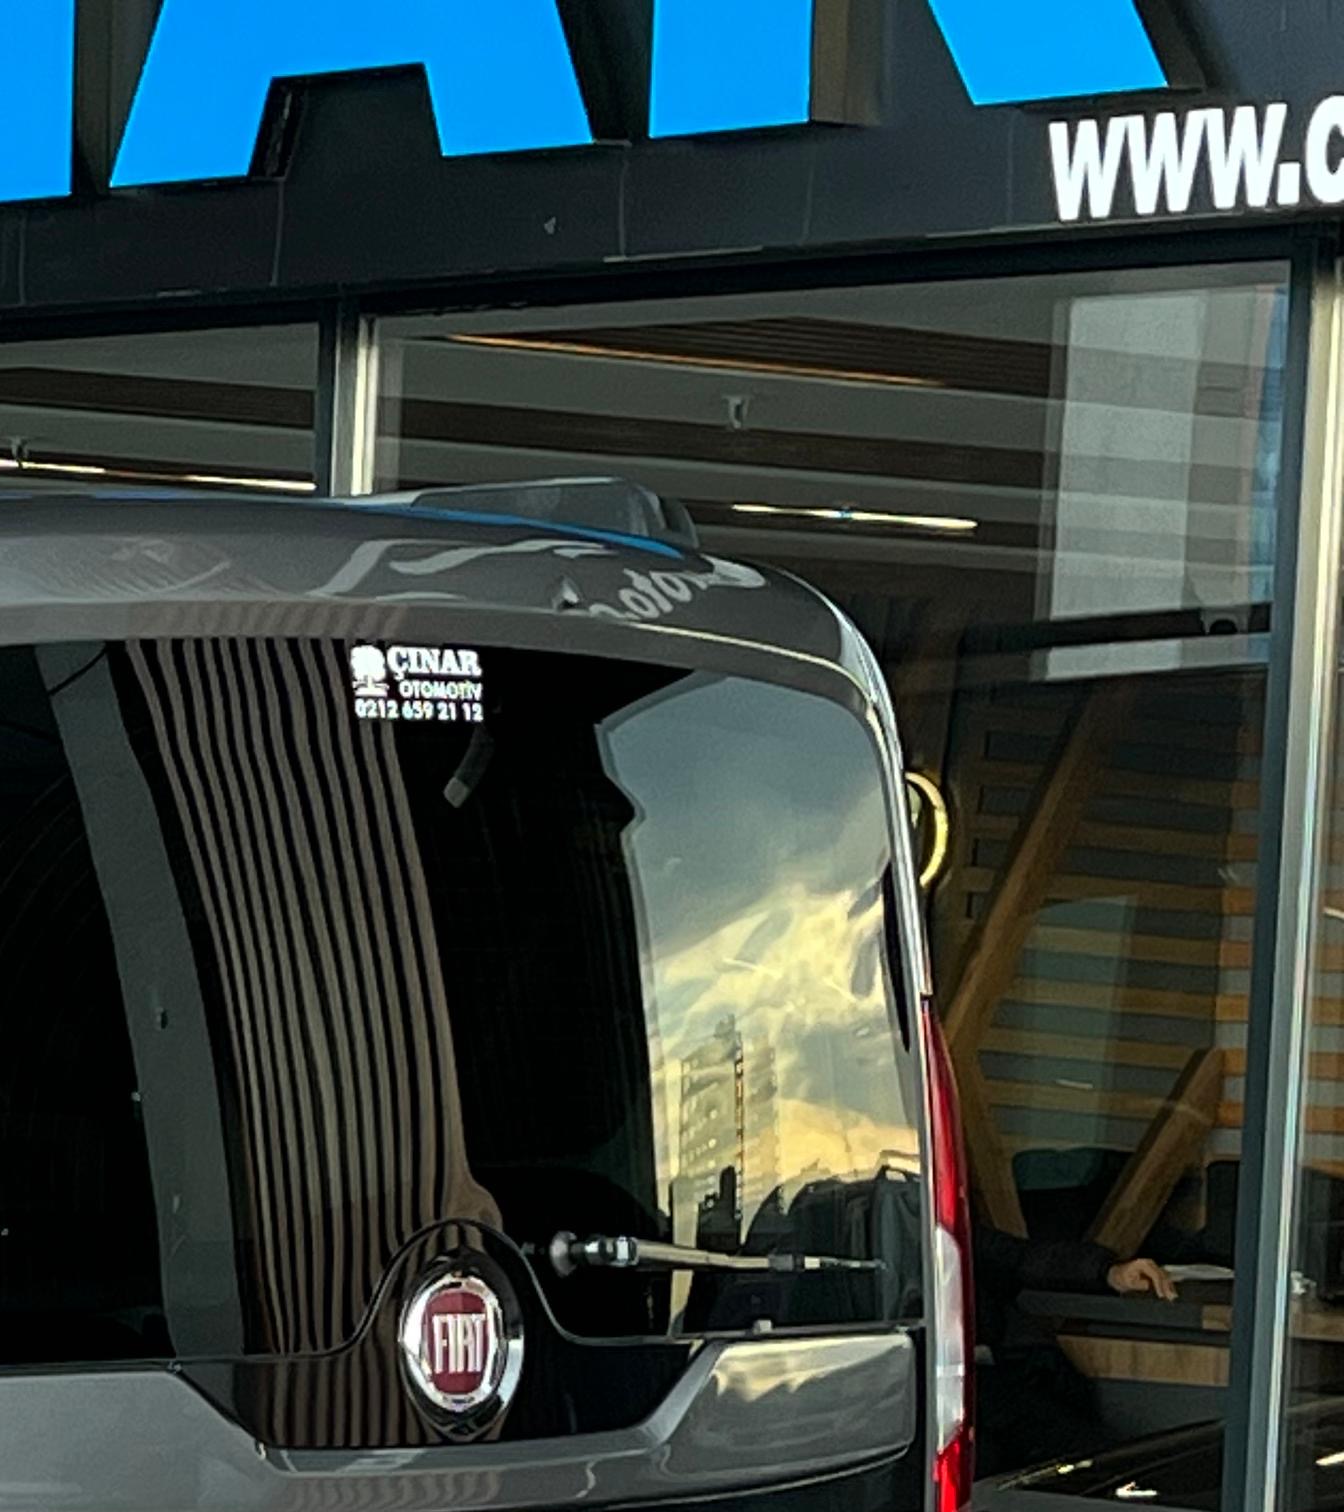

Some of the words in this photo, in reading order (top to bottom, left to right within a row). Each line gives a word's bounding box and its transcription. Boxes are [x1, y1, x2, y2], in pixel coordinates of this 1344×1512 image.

[386, 645, 482, 681] ÇINAR
[354, 698, 399, 719] 0212
[437, 702, 457, 720] 21
[462, 703, 484, 722] 12
[431, 1312, 486, 1374] FIAT
